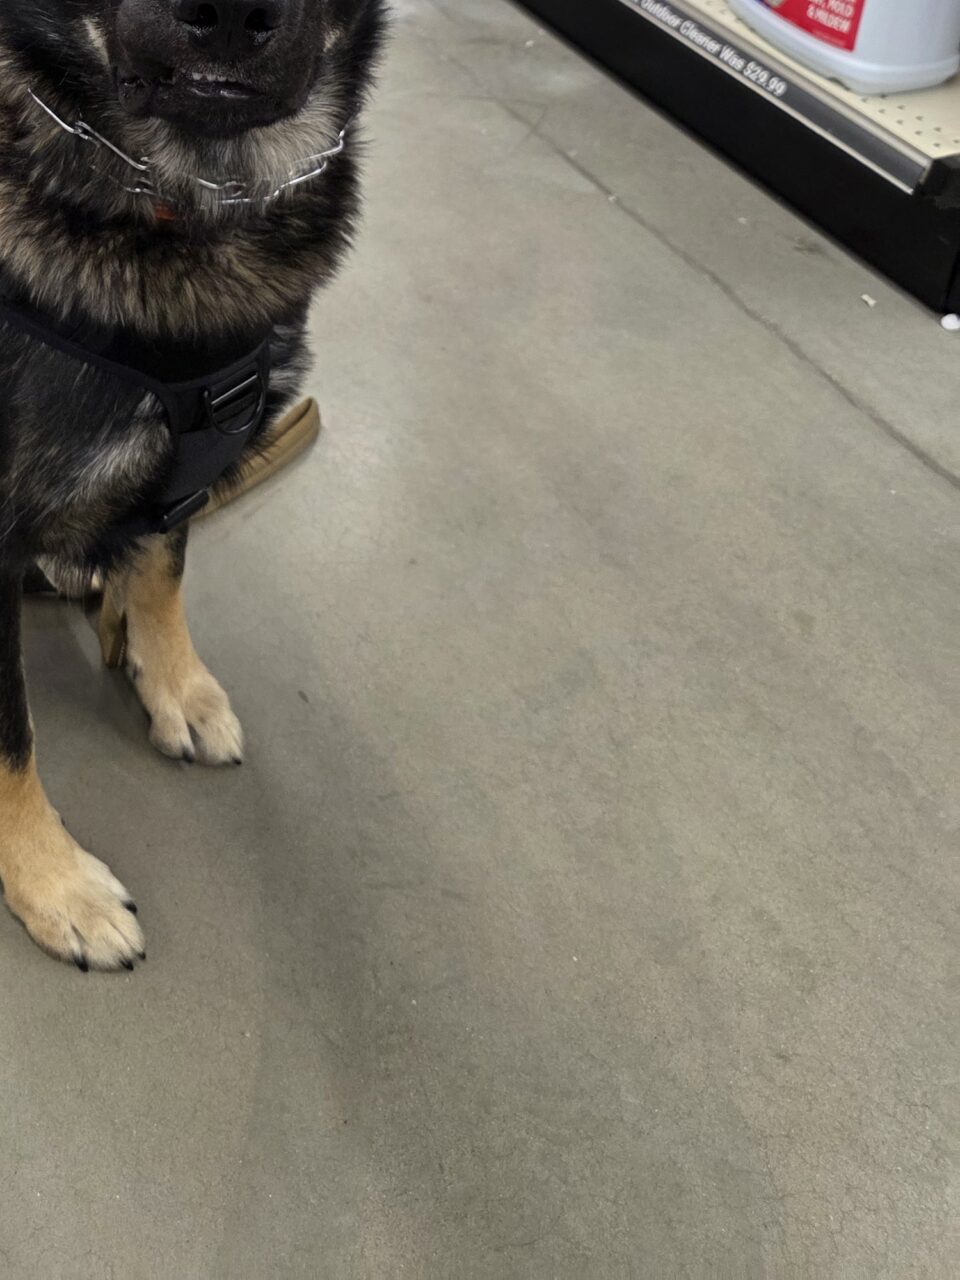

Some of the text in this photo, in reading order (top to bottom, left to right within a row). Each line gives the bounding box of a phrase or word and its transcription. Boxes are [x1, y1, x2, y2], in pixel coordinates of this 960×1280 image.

[680, 19, 723, 56] Cleaner
[719, 44, 747, 72] Was
[743, 60, 788, 97] $29.99
